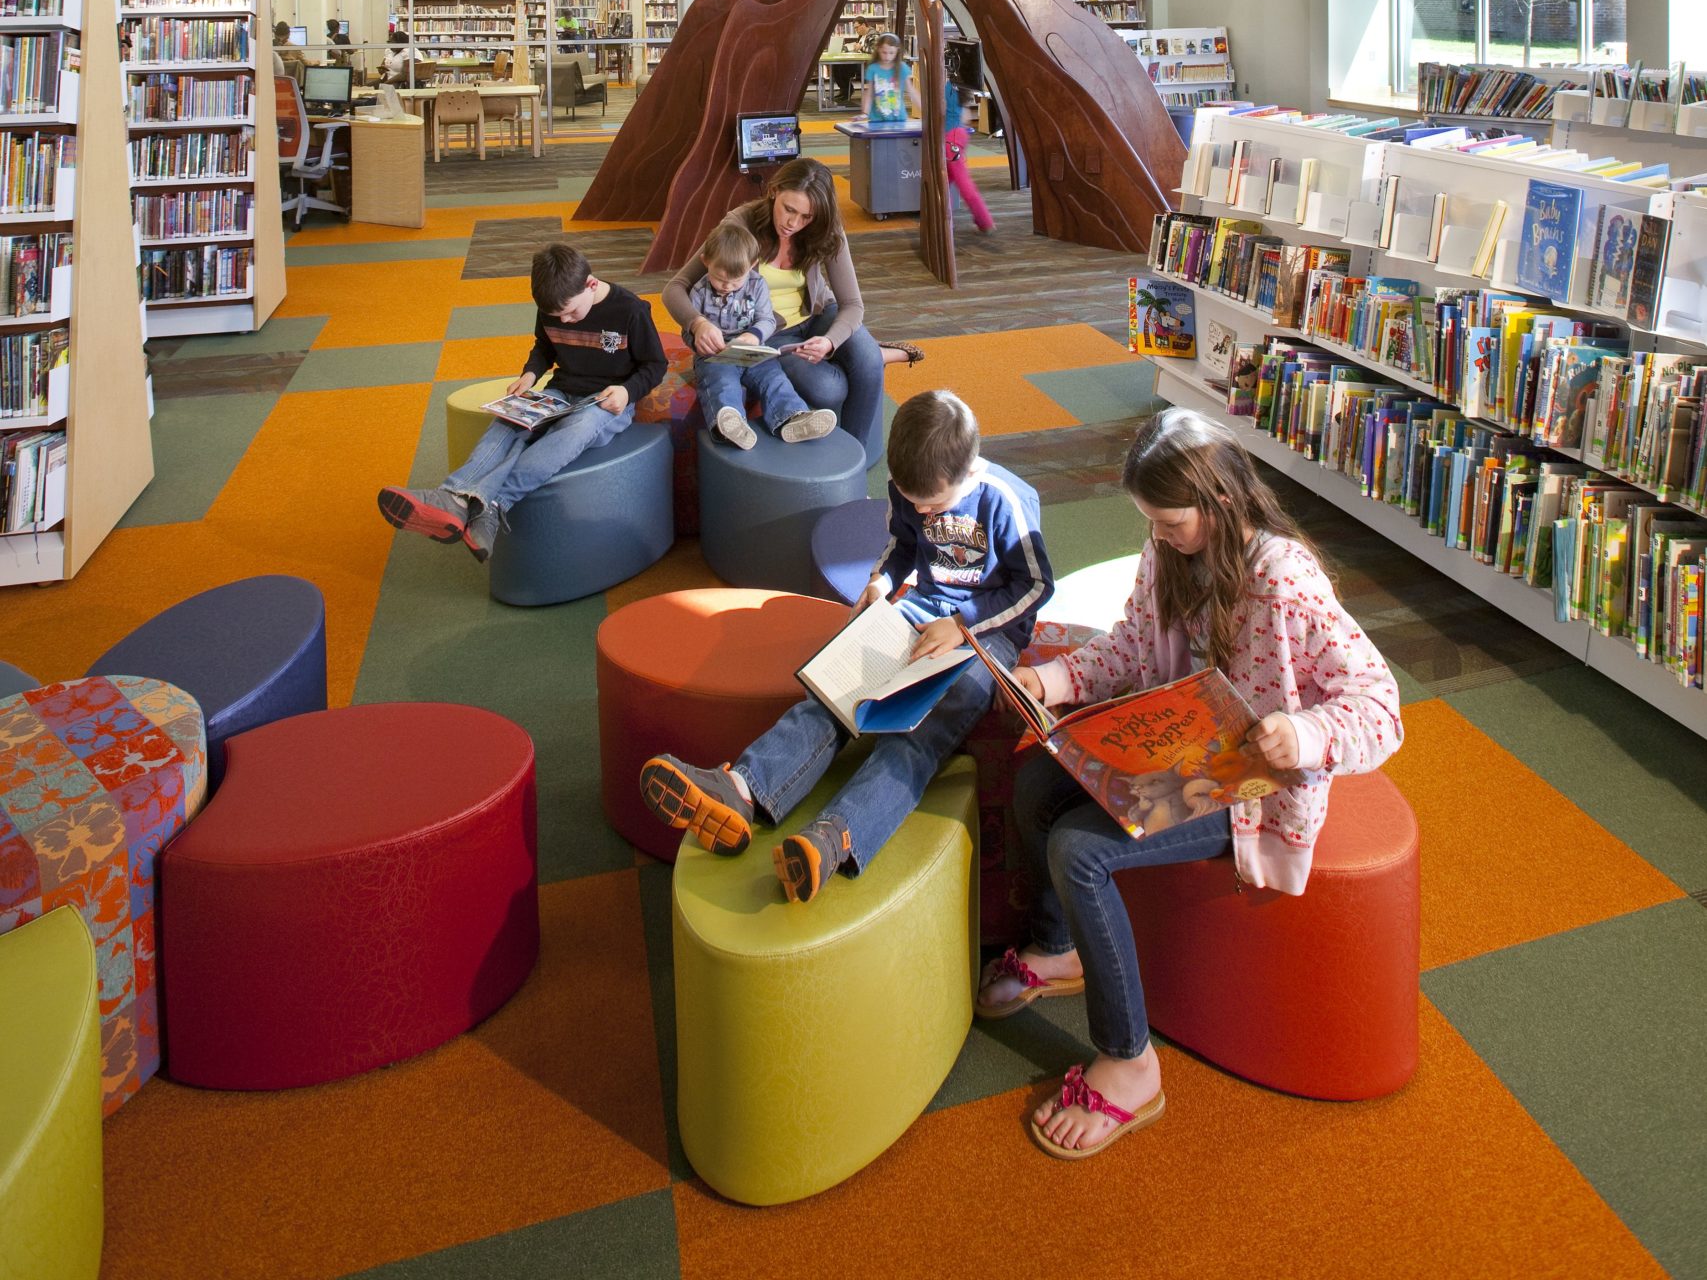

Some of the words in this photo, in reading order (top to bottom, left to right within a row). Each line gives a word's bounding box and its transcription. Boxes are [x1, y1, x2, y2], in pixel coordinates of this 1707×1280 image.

[1540, 199, 1561, 224] Baby
[1532, 223, 1565, 246] Brains
[923, 524, 988, 552] RACING
[1101, 707, 1176, 753] Pipkin
[1111, 714, 1126, 726] A
[1136, 708, 1199, 759] Pepper
